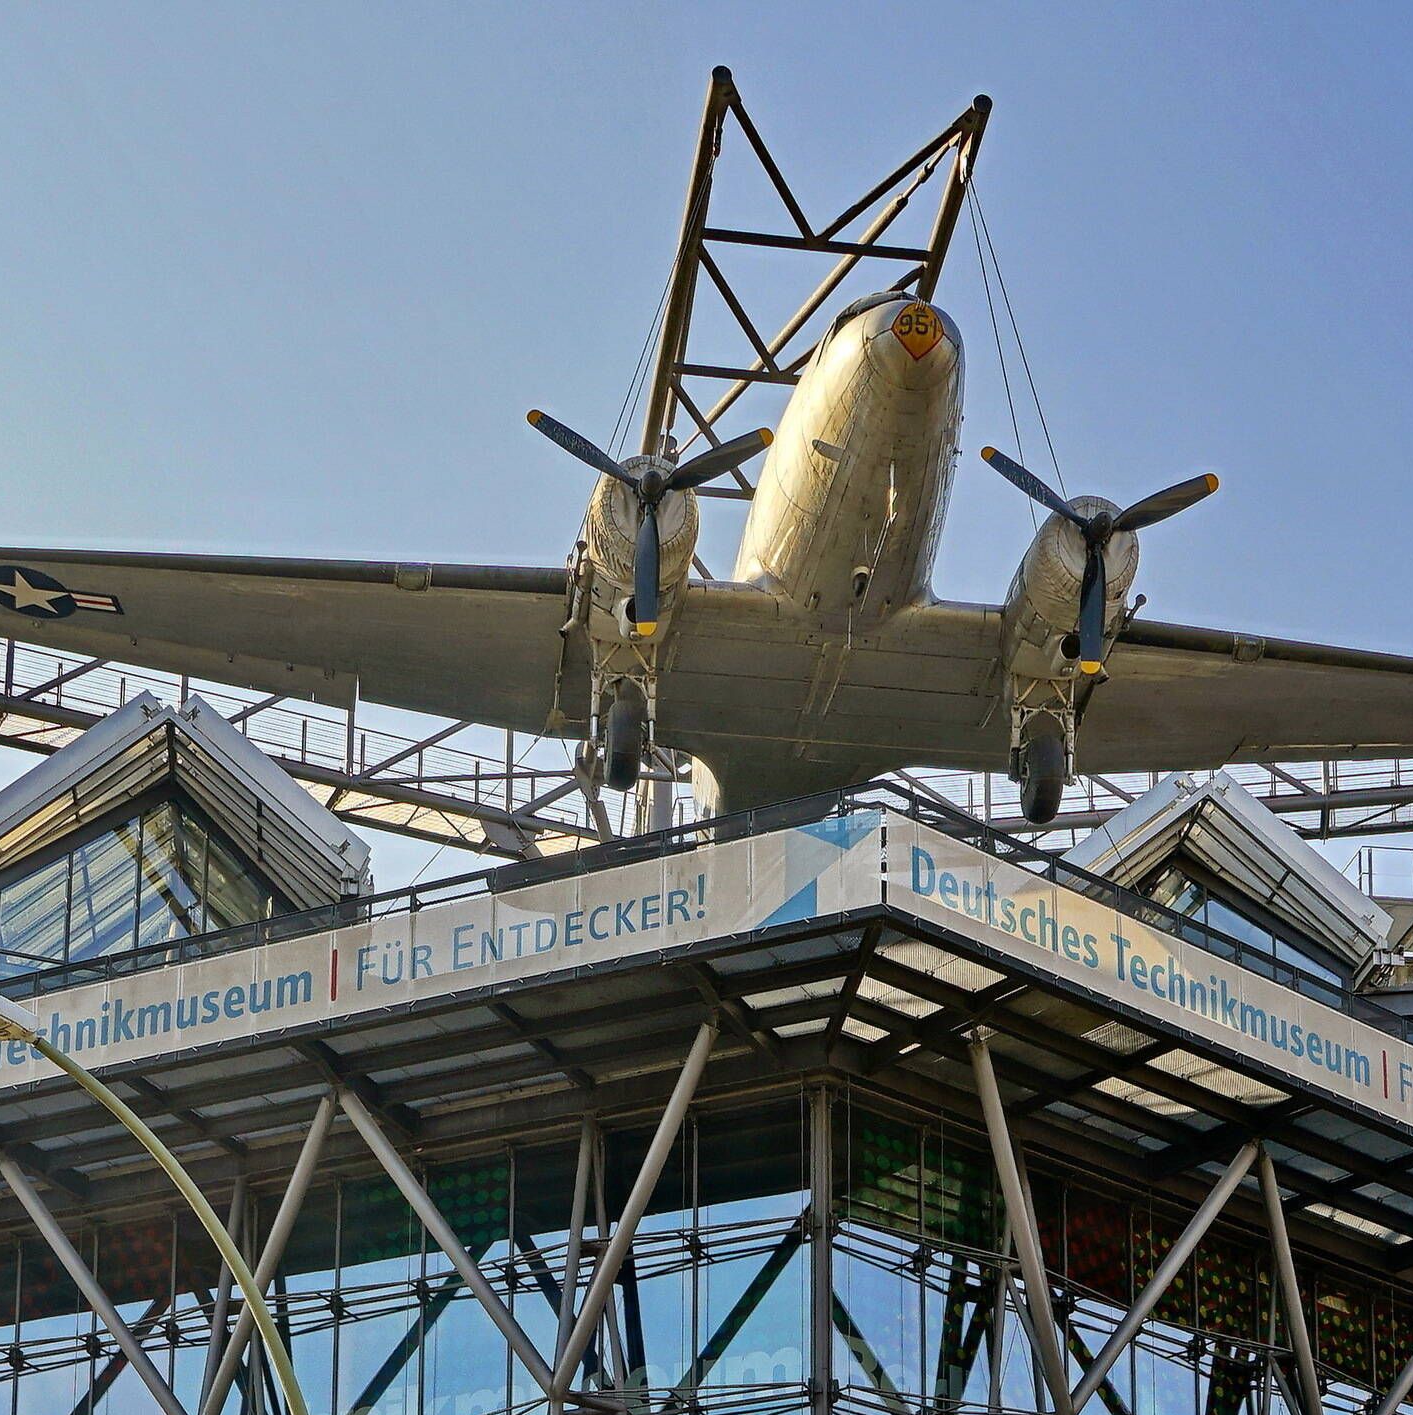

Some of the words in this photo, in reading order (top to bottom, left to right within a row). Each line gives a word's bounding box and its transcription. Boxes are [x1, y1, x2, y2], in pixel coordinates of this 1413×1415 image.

[356, 941, 434, 991] FÜR
[452, 873, 705, 971] ENTDECKER!
[911, 845, 1098, 969] Deutsches
[1110, 932, 1371, 1088] Technikmuseum
